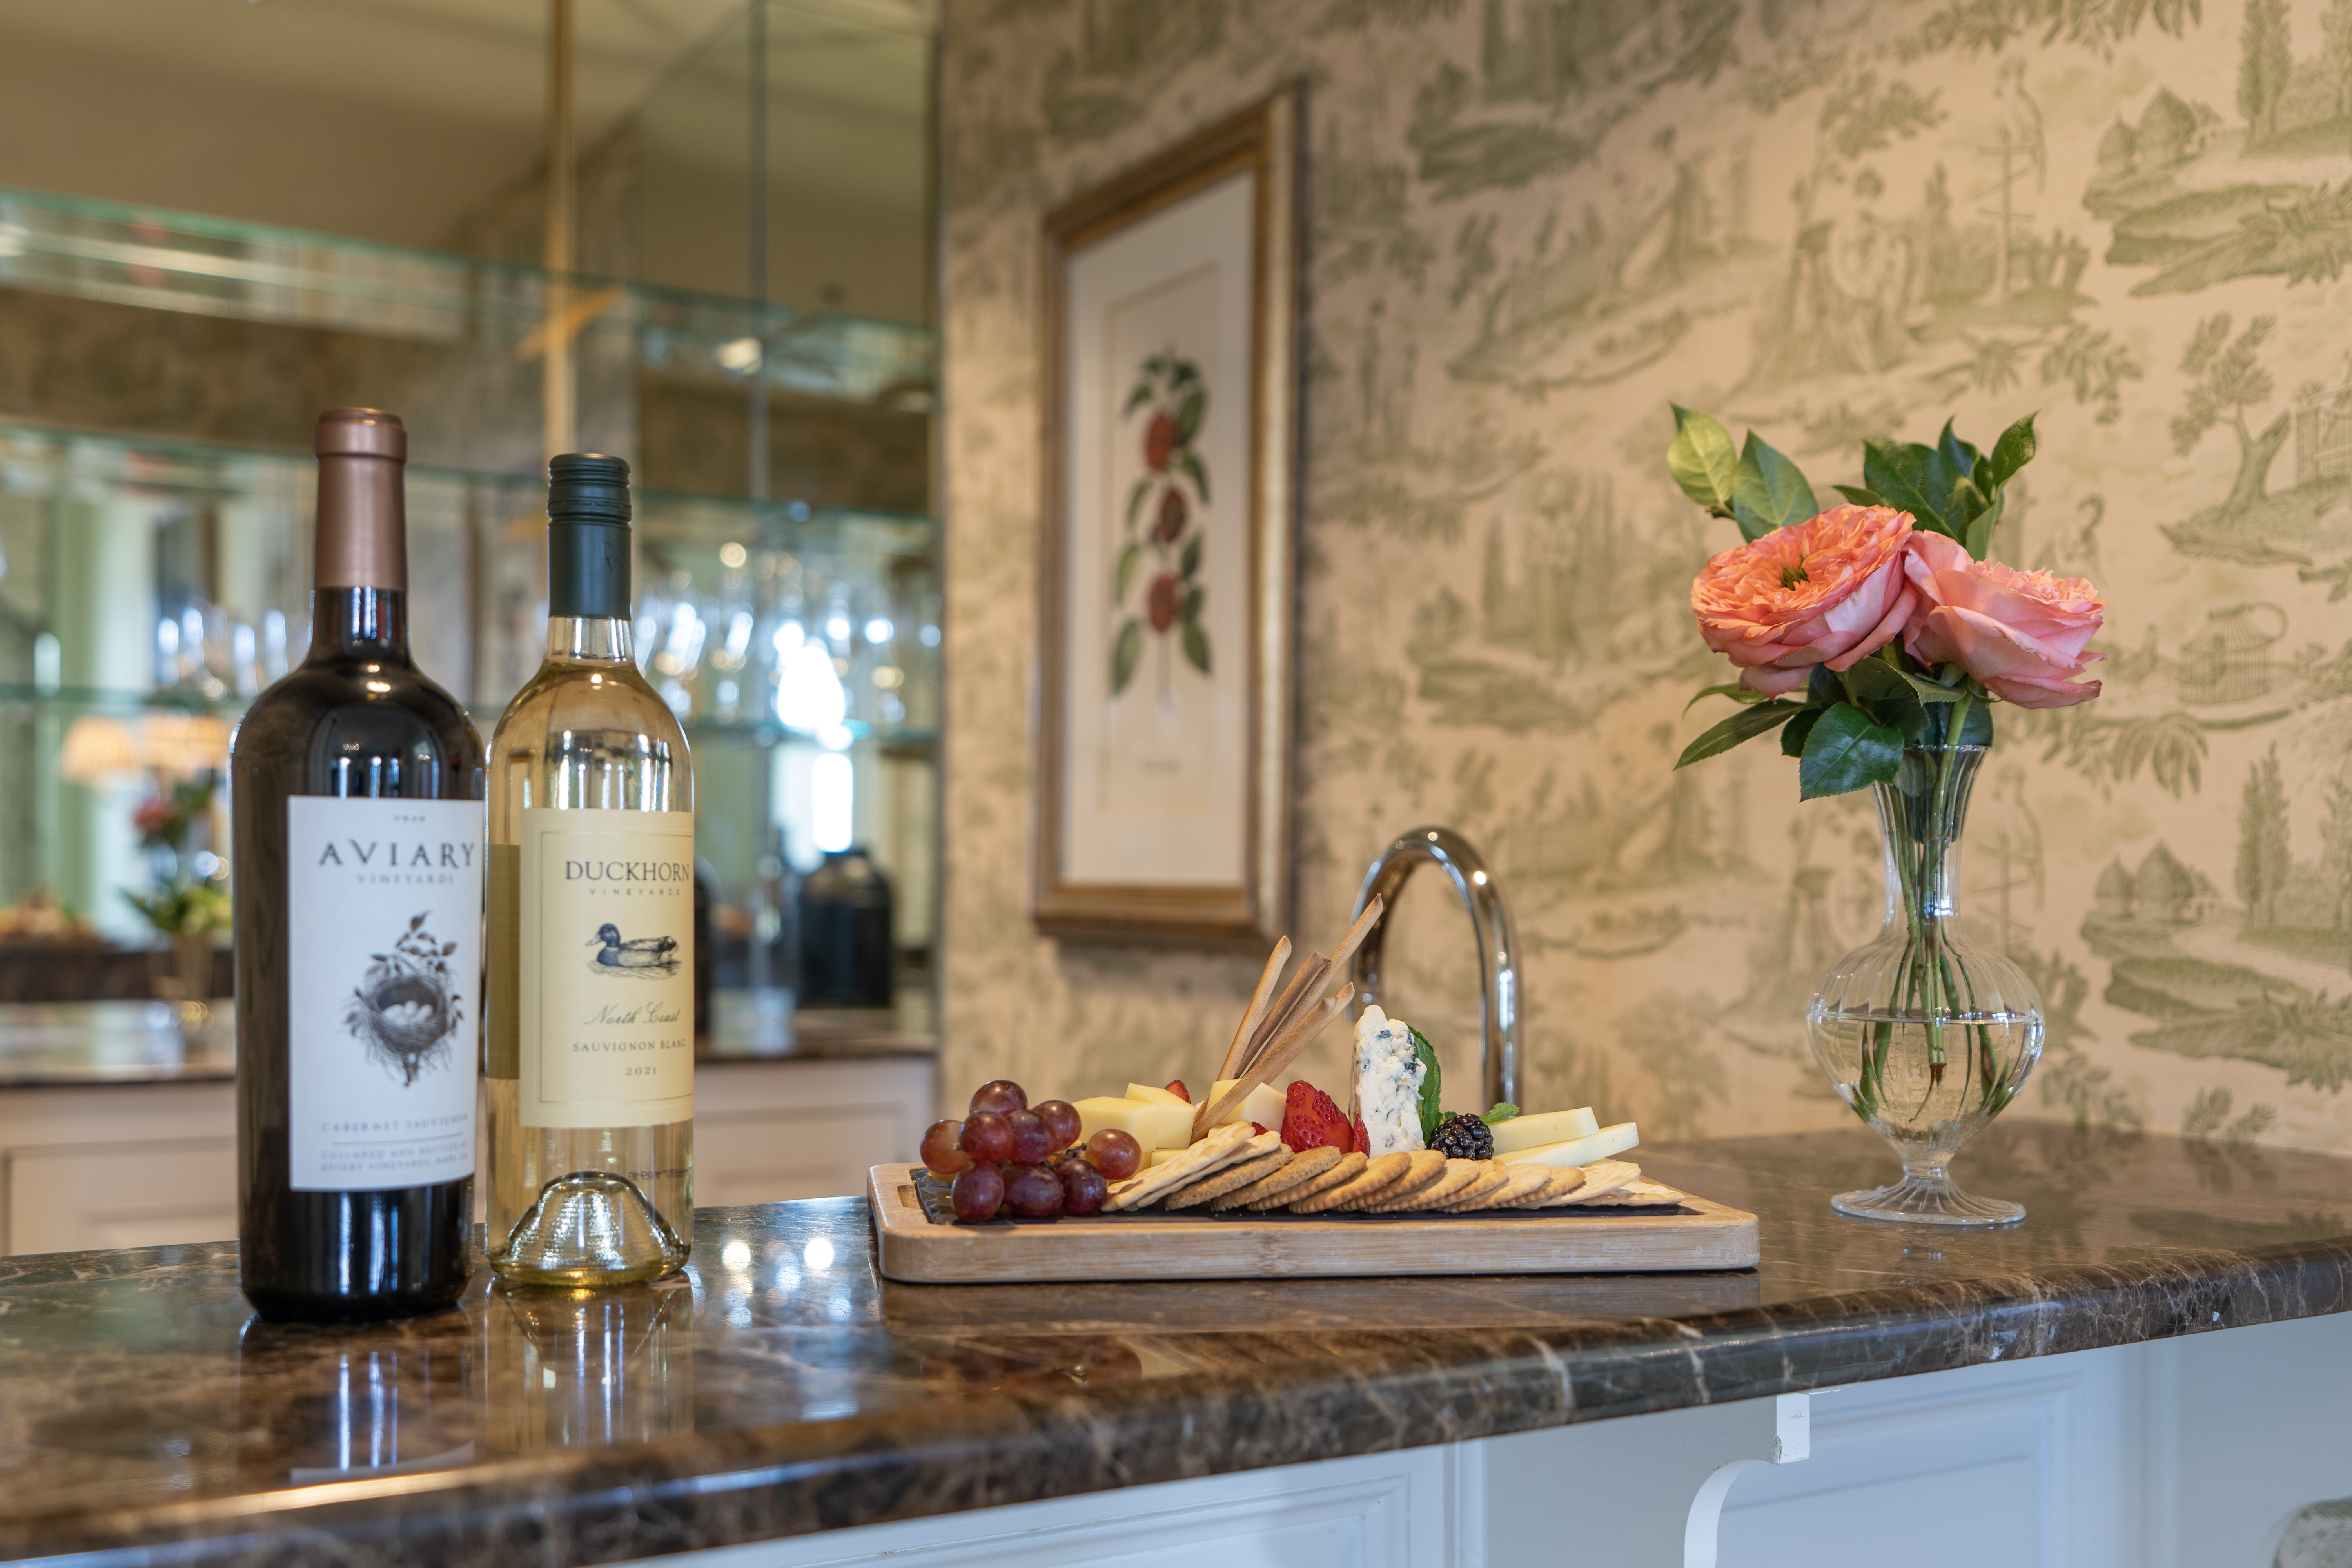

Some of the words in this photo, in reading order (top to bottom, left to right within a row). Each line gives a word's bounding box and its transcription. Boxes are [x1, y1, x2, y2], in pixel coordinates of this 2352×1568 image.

[318, 838, 475, 869] AVIARY
[566, 860, 690, 882] DUCKHORN
[356, 873, 454, 884] VINEYARDS
[590, 888, 681, 896] VINEYARDS
[583, 1002, 644, 1025] North
[643, 1001, 681, 1024] Coast
[572, 1041, 655, 1052] SAUVIGNON
[660, 1038, 687, 1049] BLANC
[625, 1066, 657, 1075] 2021
[320, 1120, 401, 1132] CABERNET
